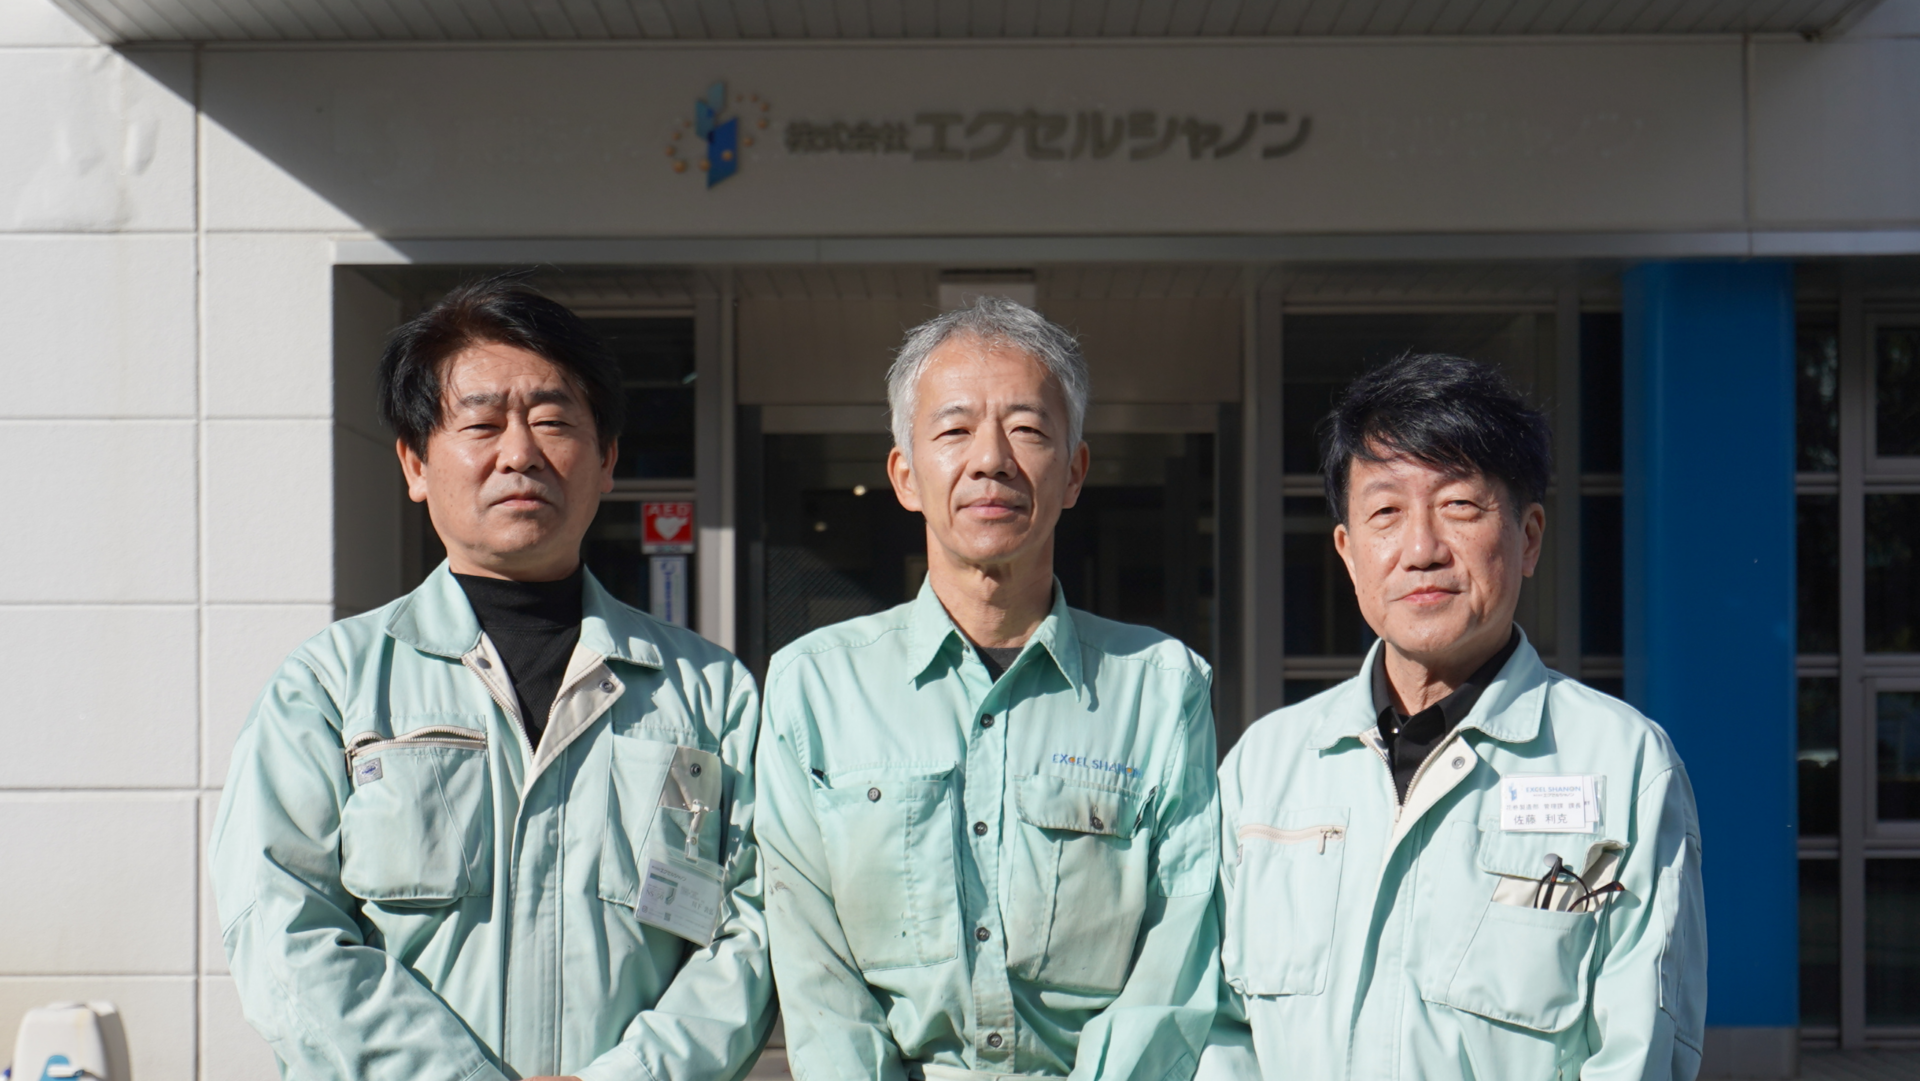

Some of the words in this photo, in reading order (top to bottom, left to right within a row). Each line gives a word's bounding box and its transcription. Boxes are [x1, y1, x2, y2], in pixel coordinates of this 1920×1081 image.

[783, 110, 1312, 162] 株式会社エクセルシャノン
[647, 503, 690, 516] AED
[1052, 753, 1089, 768] EXCEL
[1514, 814, 1536, 825] 佐藤
[1545, 813, 1568, 825] 利克
